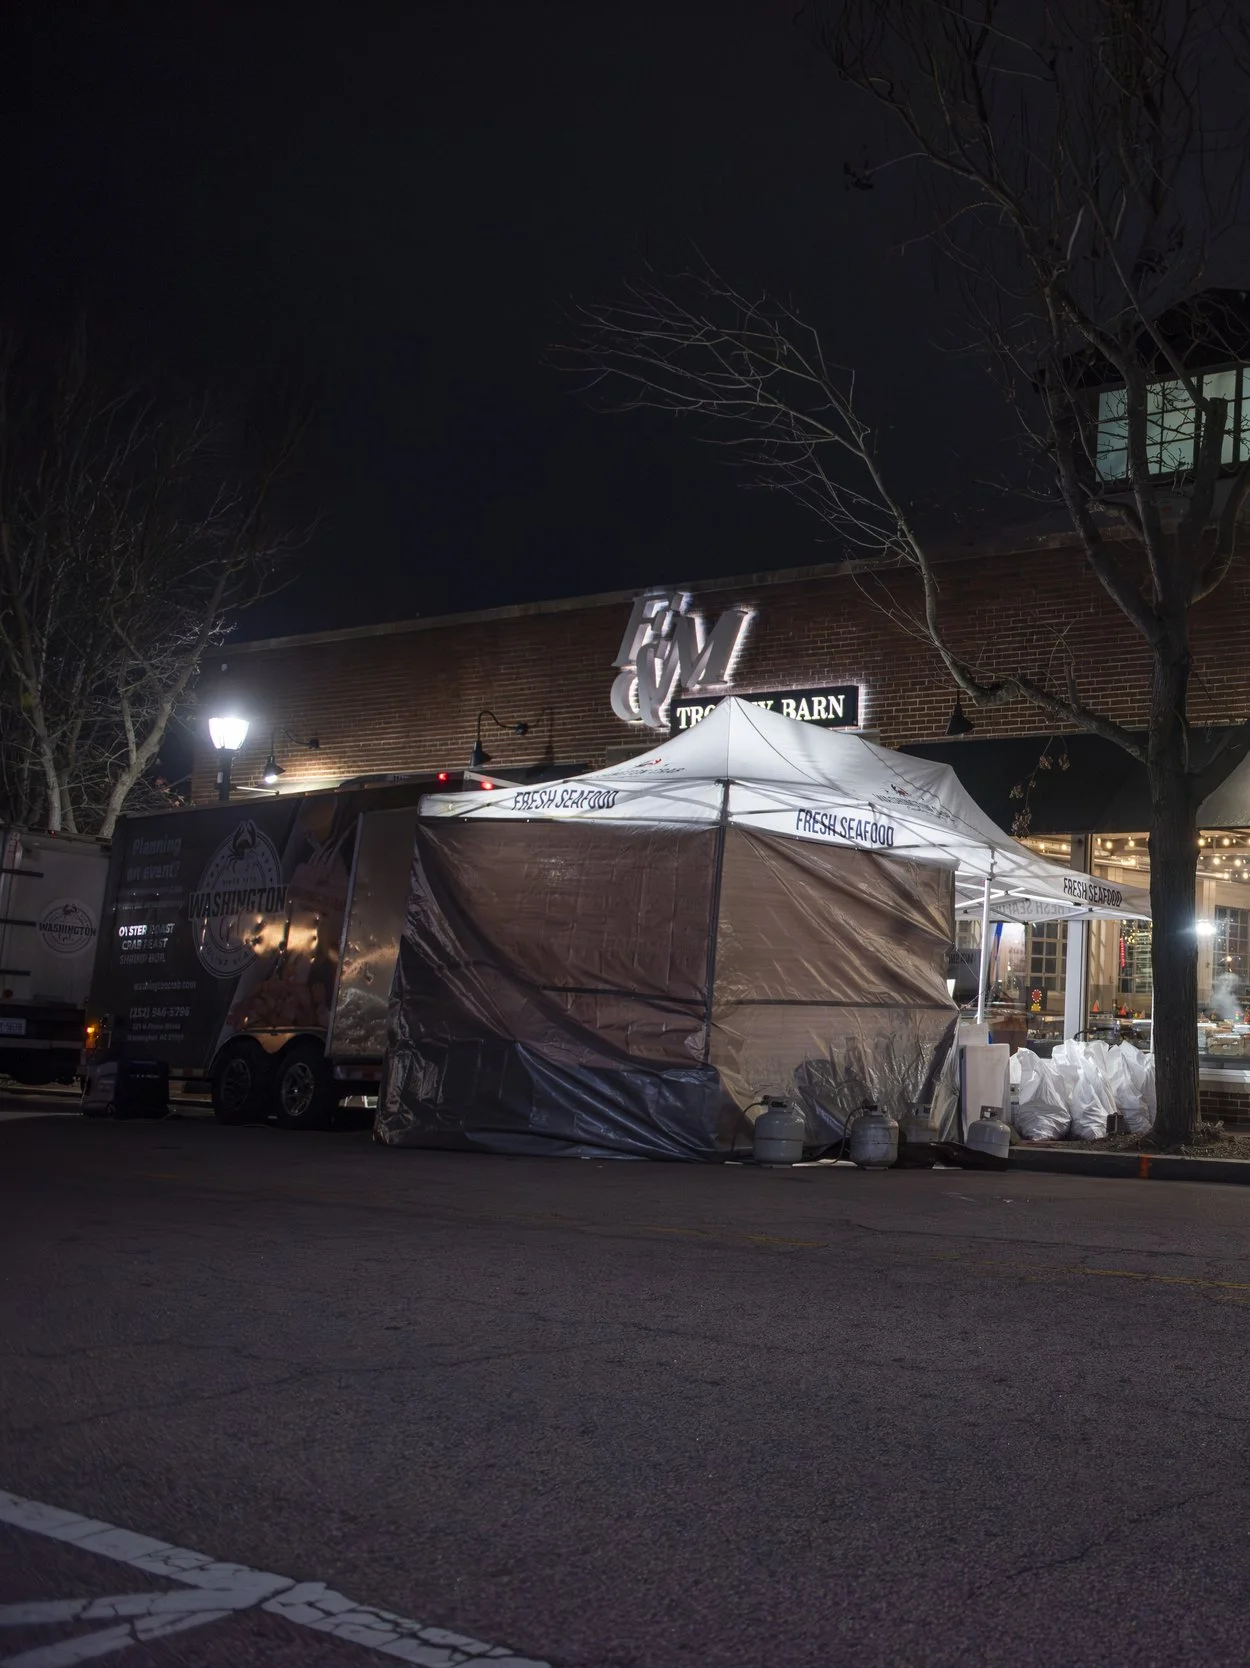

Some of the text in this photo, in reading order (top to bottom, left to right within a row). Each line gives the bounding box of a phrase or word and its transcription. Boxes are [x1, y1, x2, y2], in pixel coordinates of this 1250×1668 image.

[781, 695, 846, 721] BARN
[512, 789, 619, 811] FRESH SEAFOOD
[796, 809, 894, 848] FRESH SEAFOOD
[132, 833, 182, 856] Planning
[189, 886, 288, 919] WASHINGTON
[1063, 877, 1123, 908] FRESH SEAFOOD
[39, 921, 97, 937] WASHINGTON
[118, 924, 148, 937] OYSTER
[122, 939, 143, 951] CRAB
